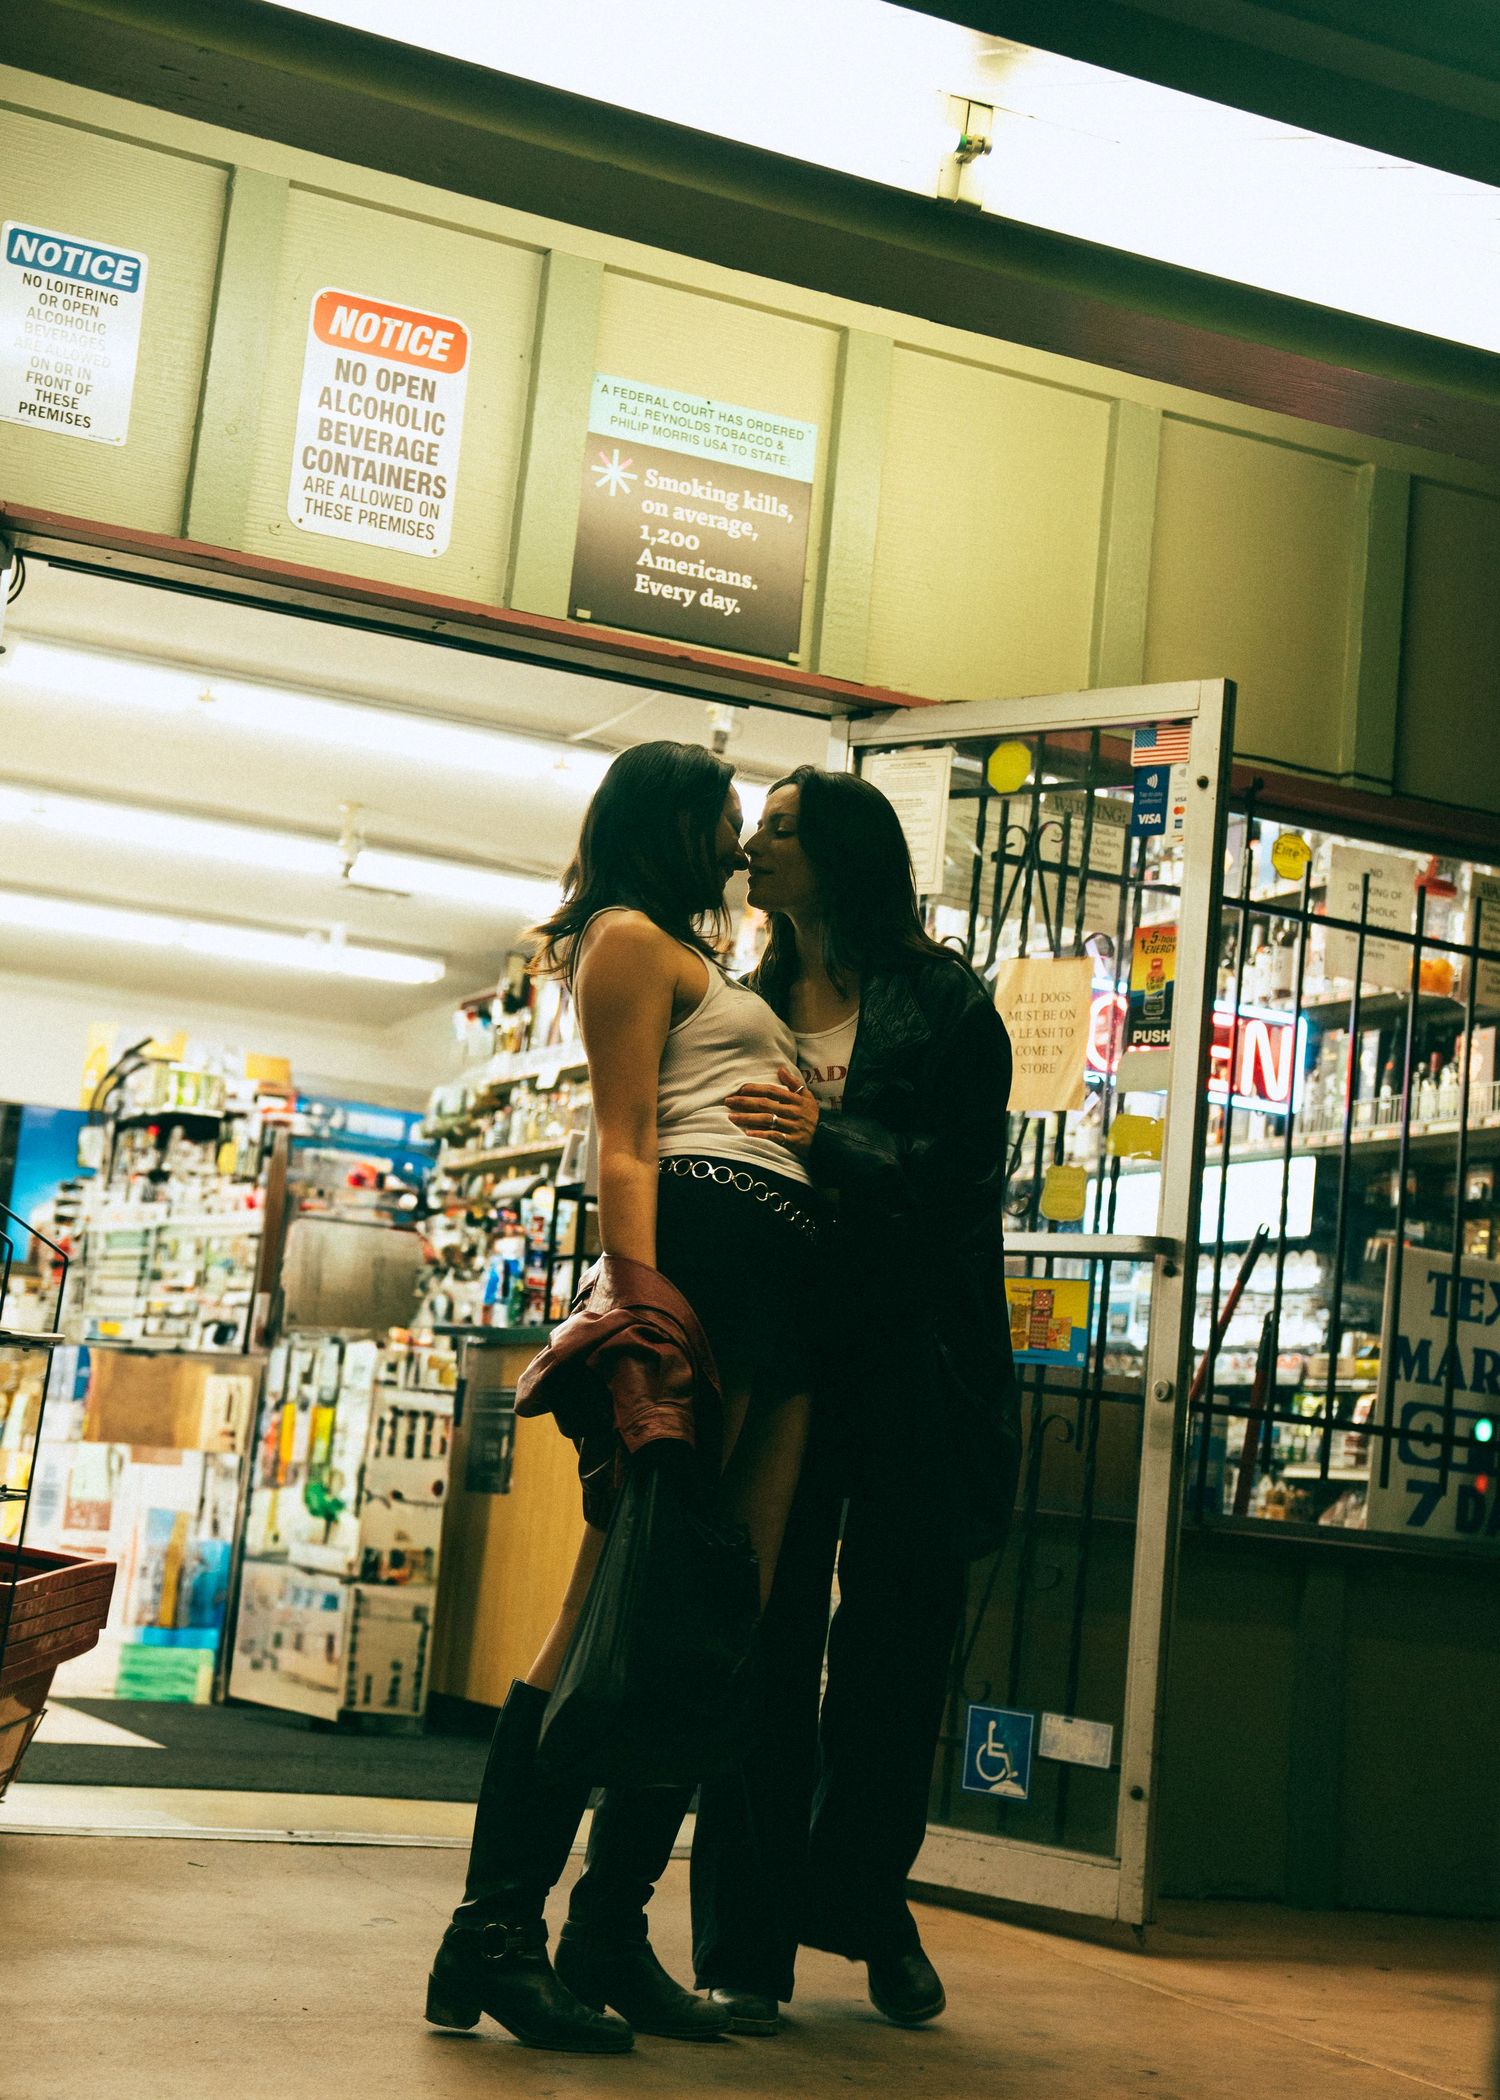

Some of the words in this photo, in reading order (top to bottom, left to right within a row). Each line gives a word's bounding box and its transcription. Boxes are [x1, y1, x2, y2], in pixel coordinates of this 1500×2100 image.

[11, 234, 139, 288] NOTICE
[22, 272, 42, 288] NO
[46, 278, 119, 307] LOITERING
[39, 292, 58, 308] OR
[62, 298, 99, 318] OPEN
[26, 306, 107, 336] ALCOHOLIC
[328, 305, 455, 362] NOTICE
[30, 355, 50, 371] ON
[54, 361, 73, 377] OR
[77, 366, 92, 381] IN
[334, 357, 367, 387] NO
[375, 366, 436, 404] OPEN
[26, 370, 72, 393] FRONT
[75, 381, 94, 397] OF
[35, 388, 80, 410] THESE
[318, 386, 446, 437] ALCOHOLIC
[600, 383, 610, 395] A
[613, 386, 669, 410] FEDERAL
[673, 400, 715, 420] COURT
[719, 411, 744, 427] HAS
[746, 418, 805, 441] ORDERED
[19, 401, 92, 429] PREMISES
[619, 402, 642, 417] R.J.
[645, 408, 711, 434] REYNOLDS
[715, 425, 774, 448] TOBACCO
[776, 441, 785, 451] &
[318, 416, 440, 467] BEVERAGE
[610, 415, 650, 433] PHILIP
[652, 425, 701, 447] MORRIS
[703, 436, 728, 452] USA
[731, 443, 748, 457] TO
[302, 444, 448, 500] CONTAINERS
[303, 475, 336, 497] ARE
[339, 483, 414, 514] ALLOWED
[418, 500, 440, 520] ON
[643, 467, 740, 513] Smoking
[743, 490, 795, 525] kills,
[304, 496, 353, 523] THESE
[358, 508, 435, 541] PREMISES
[641, 500, 669, 517] on
[672, 506, 759, 542] average,
[639, 524, 701, 551] 1,200
[636, 547, 759, 591] Americans.
[634, 572, 697, 608] Every
[699, 588, 742, 617] day.
[1055, 795, 1126, 824] WARING:
[1137, 813, 1162, 825] VISA
[1276, 842, 1300, 859] Elite
[1347, 882, 1389, 899] DRKING
[1144, 943, 1177, 955] ENERGY
[1015, 993, 1035, 1004] ALL
[1040, 992, 1072, 1003] DOGS
[1007, 1010, 1040, 1021] MUST
[1043, 1010, 1057, 1021] BE
[1060, 1009, 1077, 1020] ON
[1020, 1028, 1056, 1039] LEASH
[1058, 1027, 1075, 1038] TO
[1132, 1029, 1171, 1044] PUSH
[1015, 1046, 1047, 1057] COME
[1051, 1045, 1063, 1055] IN
[1020, 1063, 1057, 1074] STORE
[1405, 1478, 1444, 1527] 7
